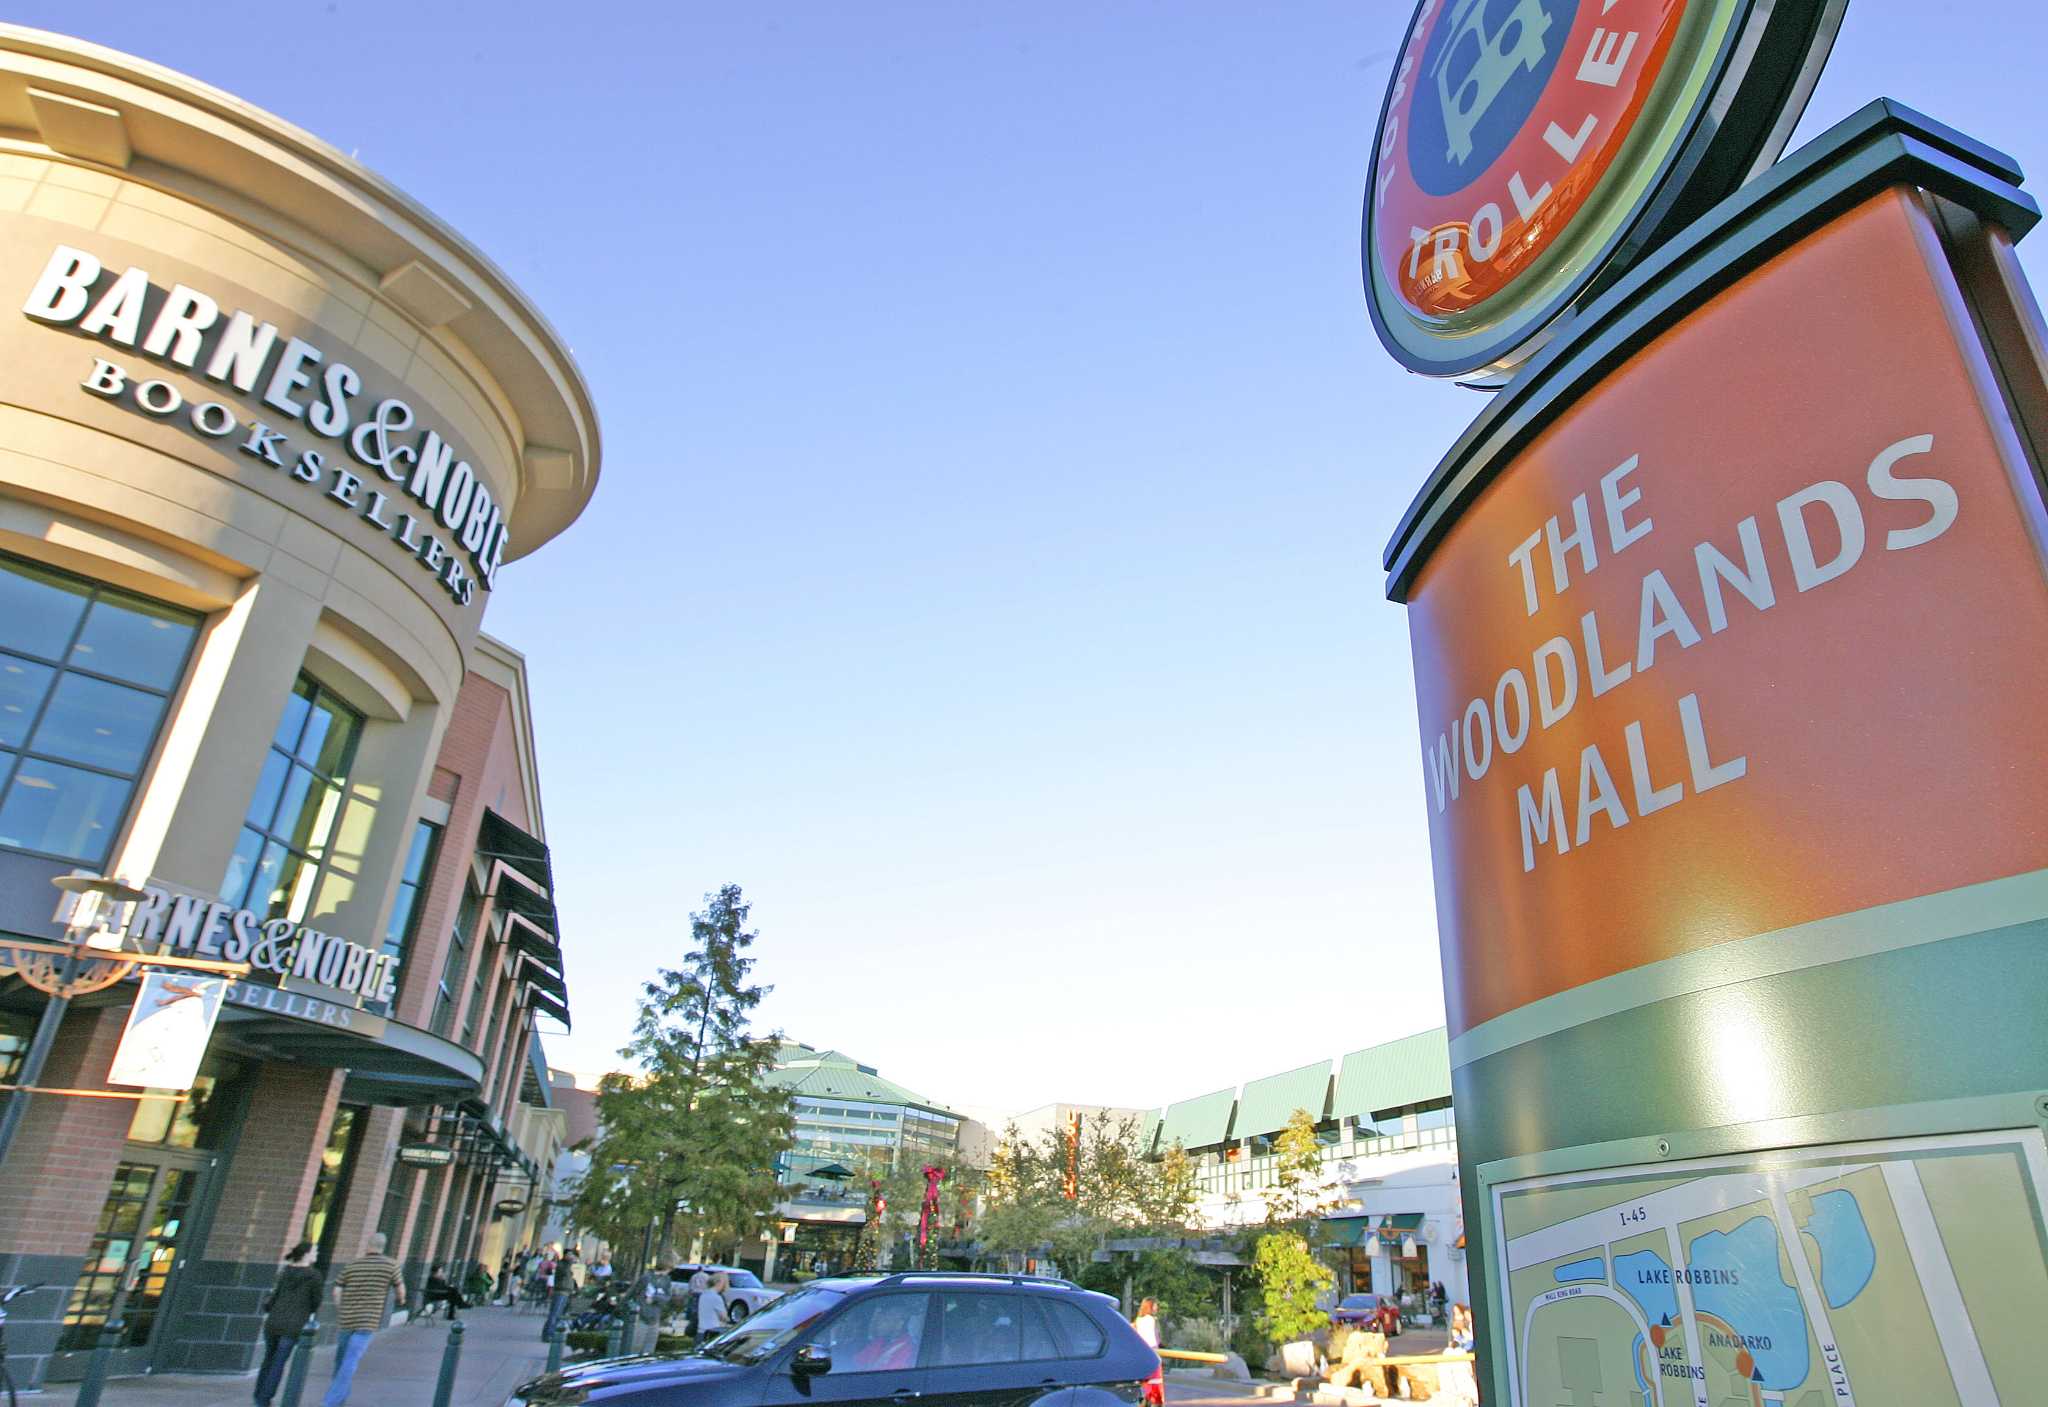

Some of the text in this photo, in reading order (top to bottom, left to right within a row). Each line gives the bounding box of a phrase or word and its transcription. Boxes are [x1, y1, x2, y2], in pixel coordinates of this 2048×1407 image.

[1408, 0, 1639, 279] TROLLE
[81, 355, 475, 606] BOOKSELLERS
[1508, 453, 1653, 617] THE
[1428, 433, 1959, 814] WOODLANDS
[1517, 693, 1746, 873] MALL
[1620, 1207, 1647, 1226] I-45
[1637, 1269, 1739, 1286] LAKE ROBBINS
[1658, 1346, 1683, 1361] LAKE
[1708, 1333, 1772, 1351] ANADARKO
[1659, 1363, 1705, 1380] ROBBINS
[1823, 1343, 1849, 1397] PLACE
